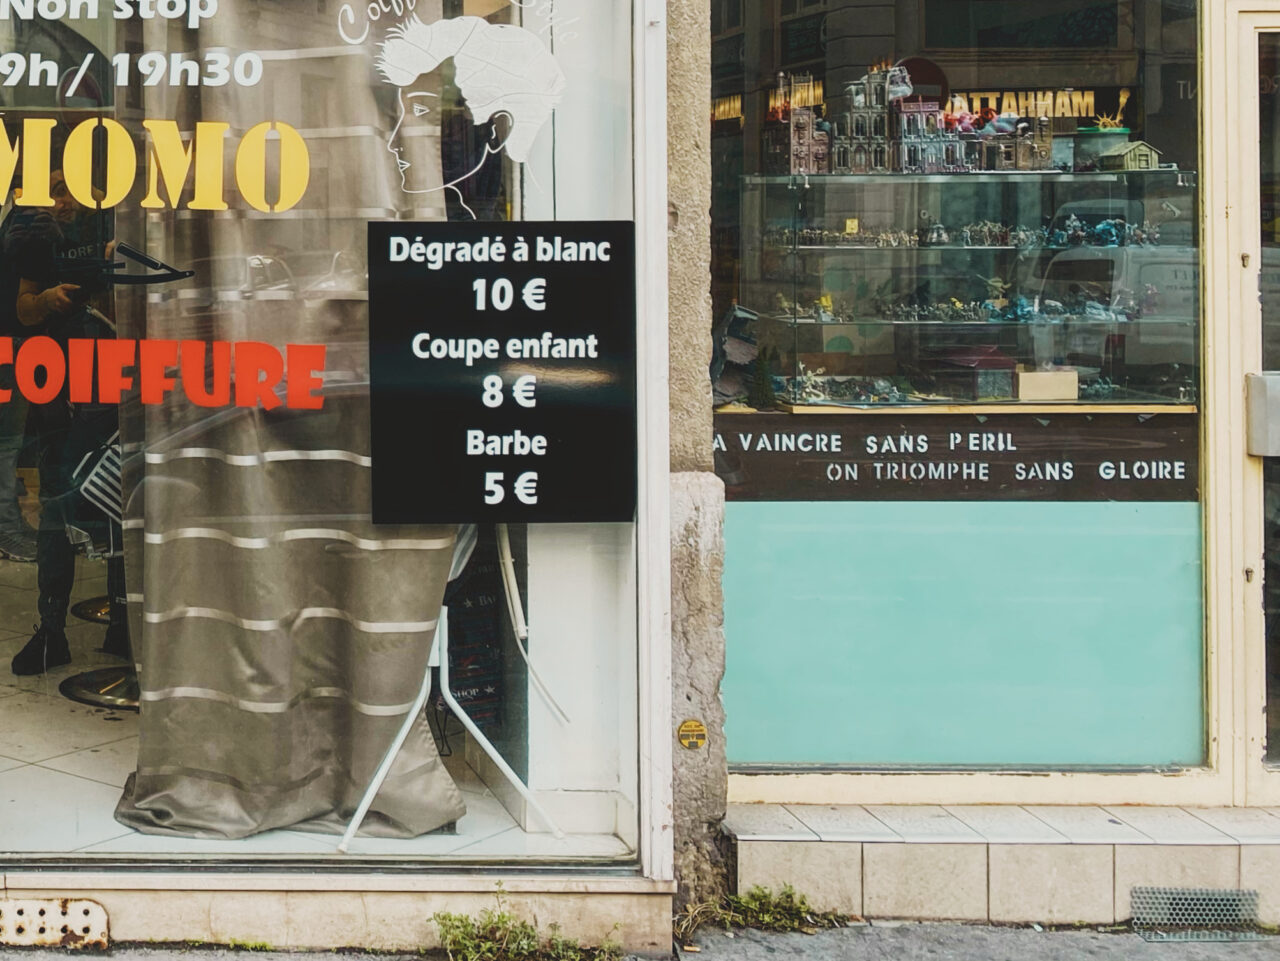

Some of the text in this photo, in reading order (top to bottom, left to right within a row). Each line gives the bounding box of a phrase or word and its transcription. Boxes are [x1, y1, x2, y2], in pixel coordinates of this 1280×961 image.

[112, 51, 263, 87] 19h30
[389, 236, 610, 270] Dégradé à blanc
[473, 278, 546, 311] 10 €
[412, 332, 598, 366] Coupe enfant
[482, 375, 537, 408] 8 €
[467, 430, 547, 455] Barbe
[713, 433, 1017, 454] A VAINCRE SANS PERIL
[826, 461, 1185, 481] ON TRIOMPHE SANS GLOIRE
[484, 471, 538, 505] 5 €
